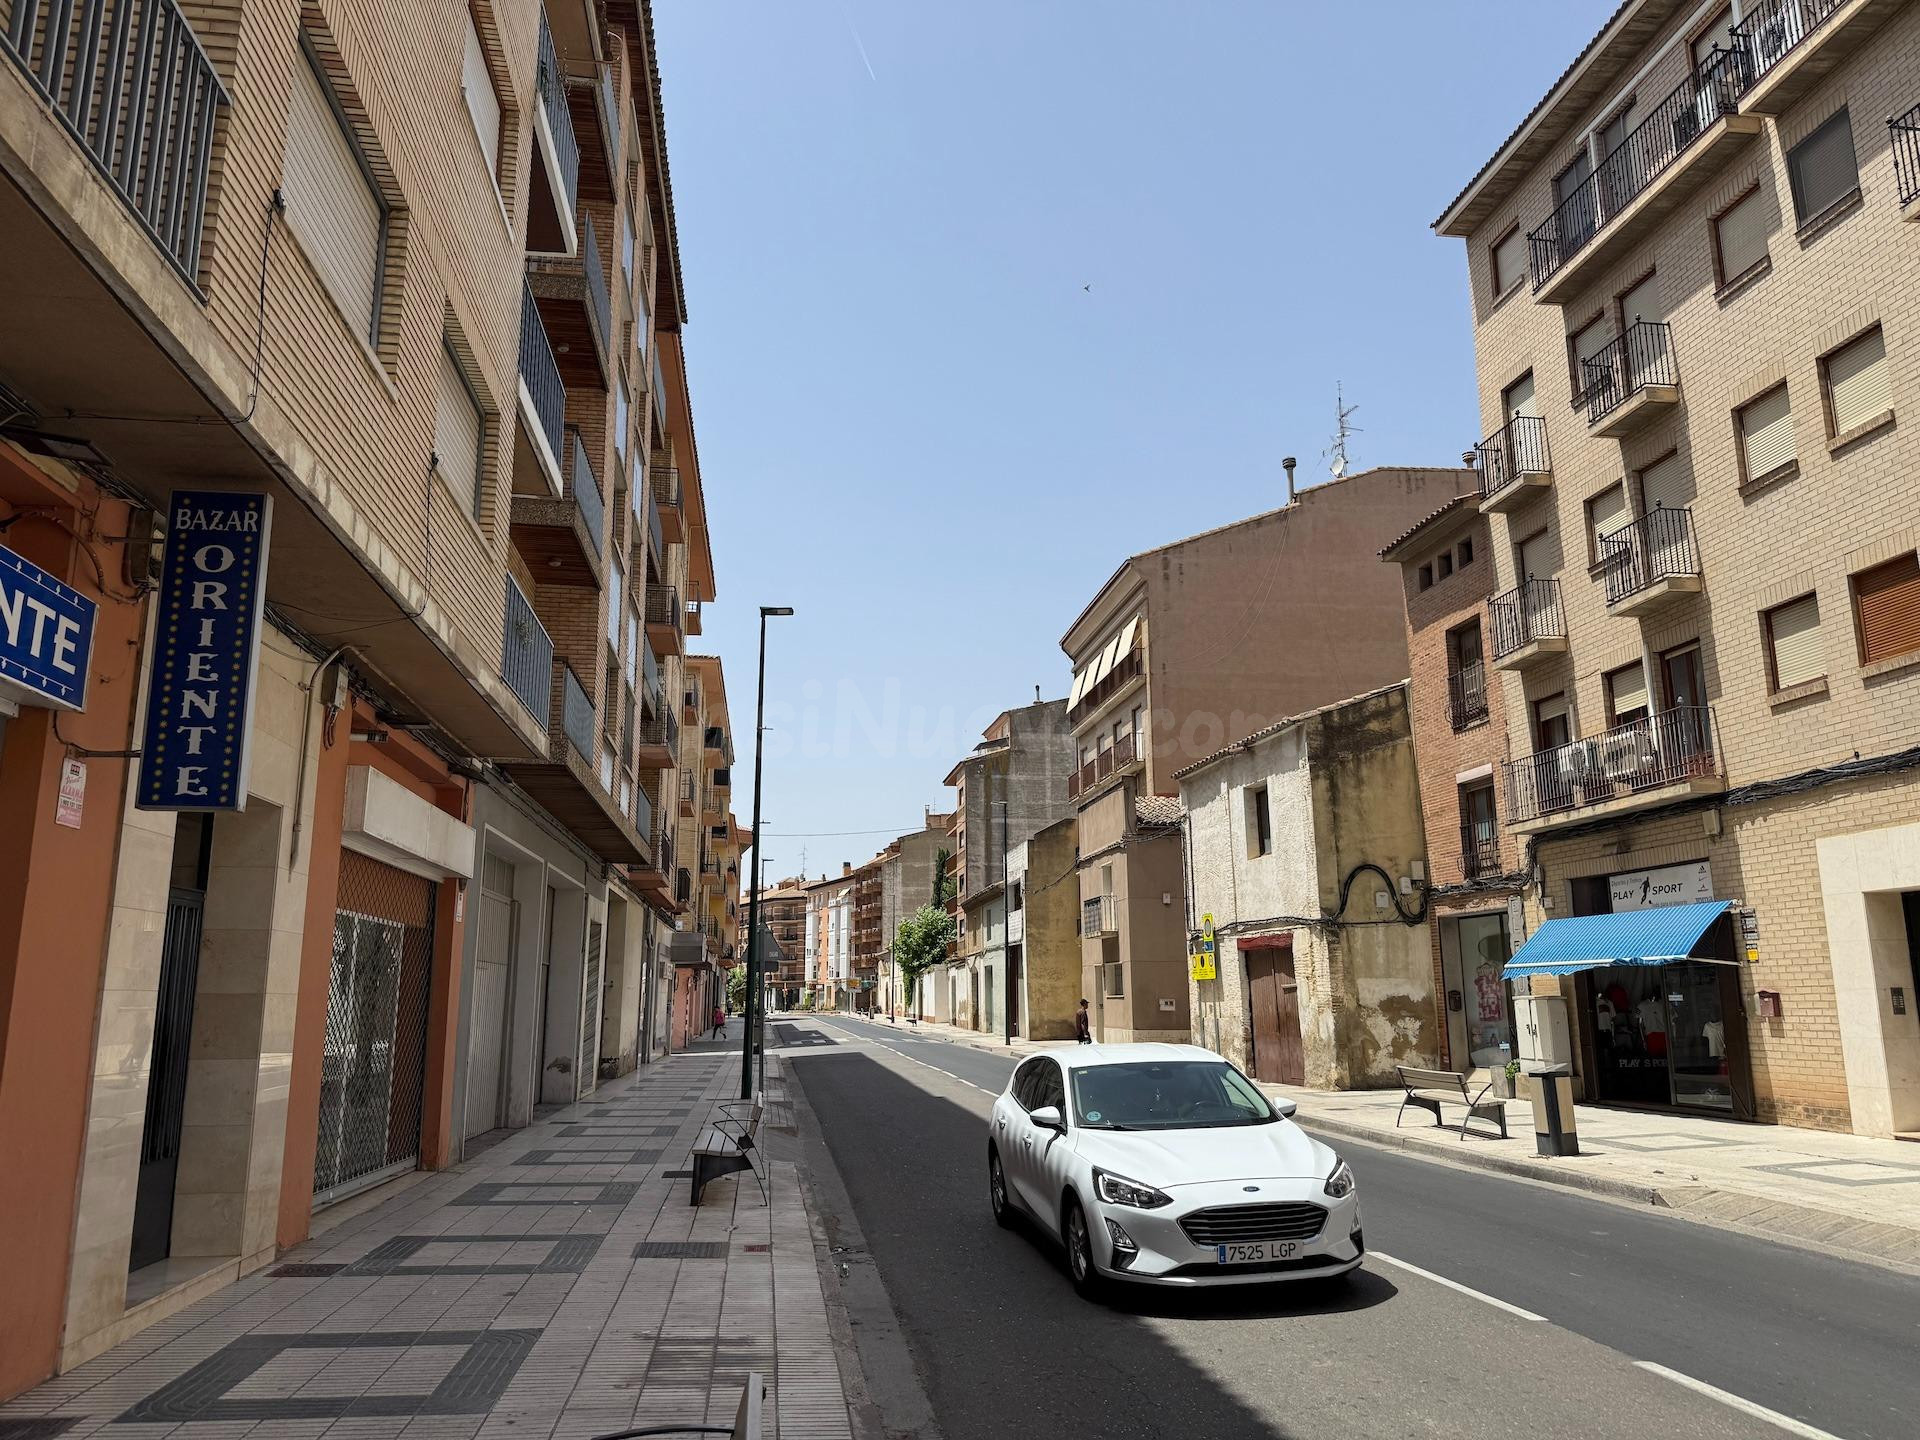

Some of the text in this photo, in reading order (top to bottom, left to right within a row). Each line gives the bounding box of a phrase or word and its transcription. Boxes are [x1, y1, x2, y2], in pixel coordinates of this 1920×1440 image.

[176, 508, 258, 532] BAZAR
[174, 545, 236, 796] ORIENTE
[1612, 889, 1634, 901] PLAY
[1652, 883, 1683, 895] SPORT
[1618, 1058, 1640, 1068] PLAY
[1229, 1242, 1296, 1261] 7525 LGP
